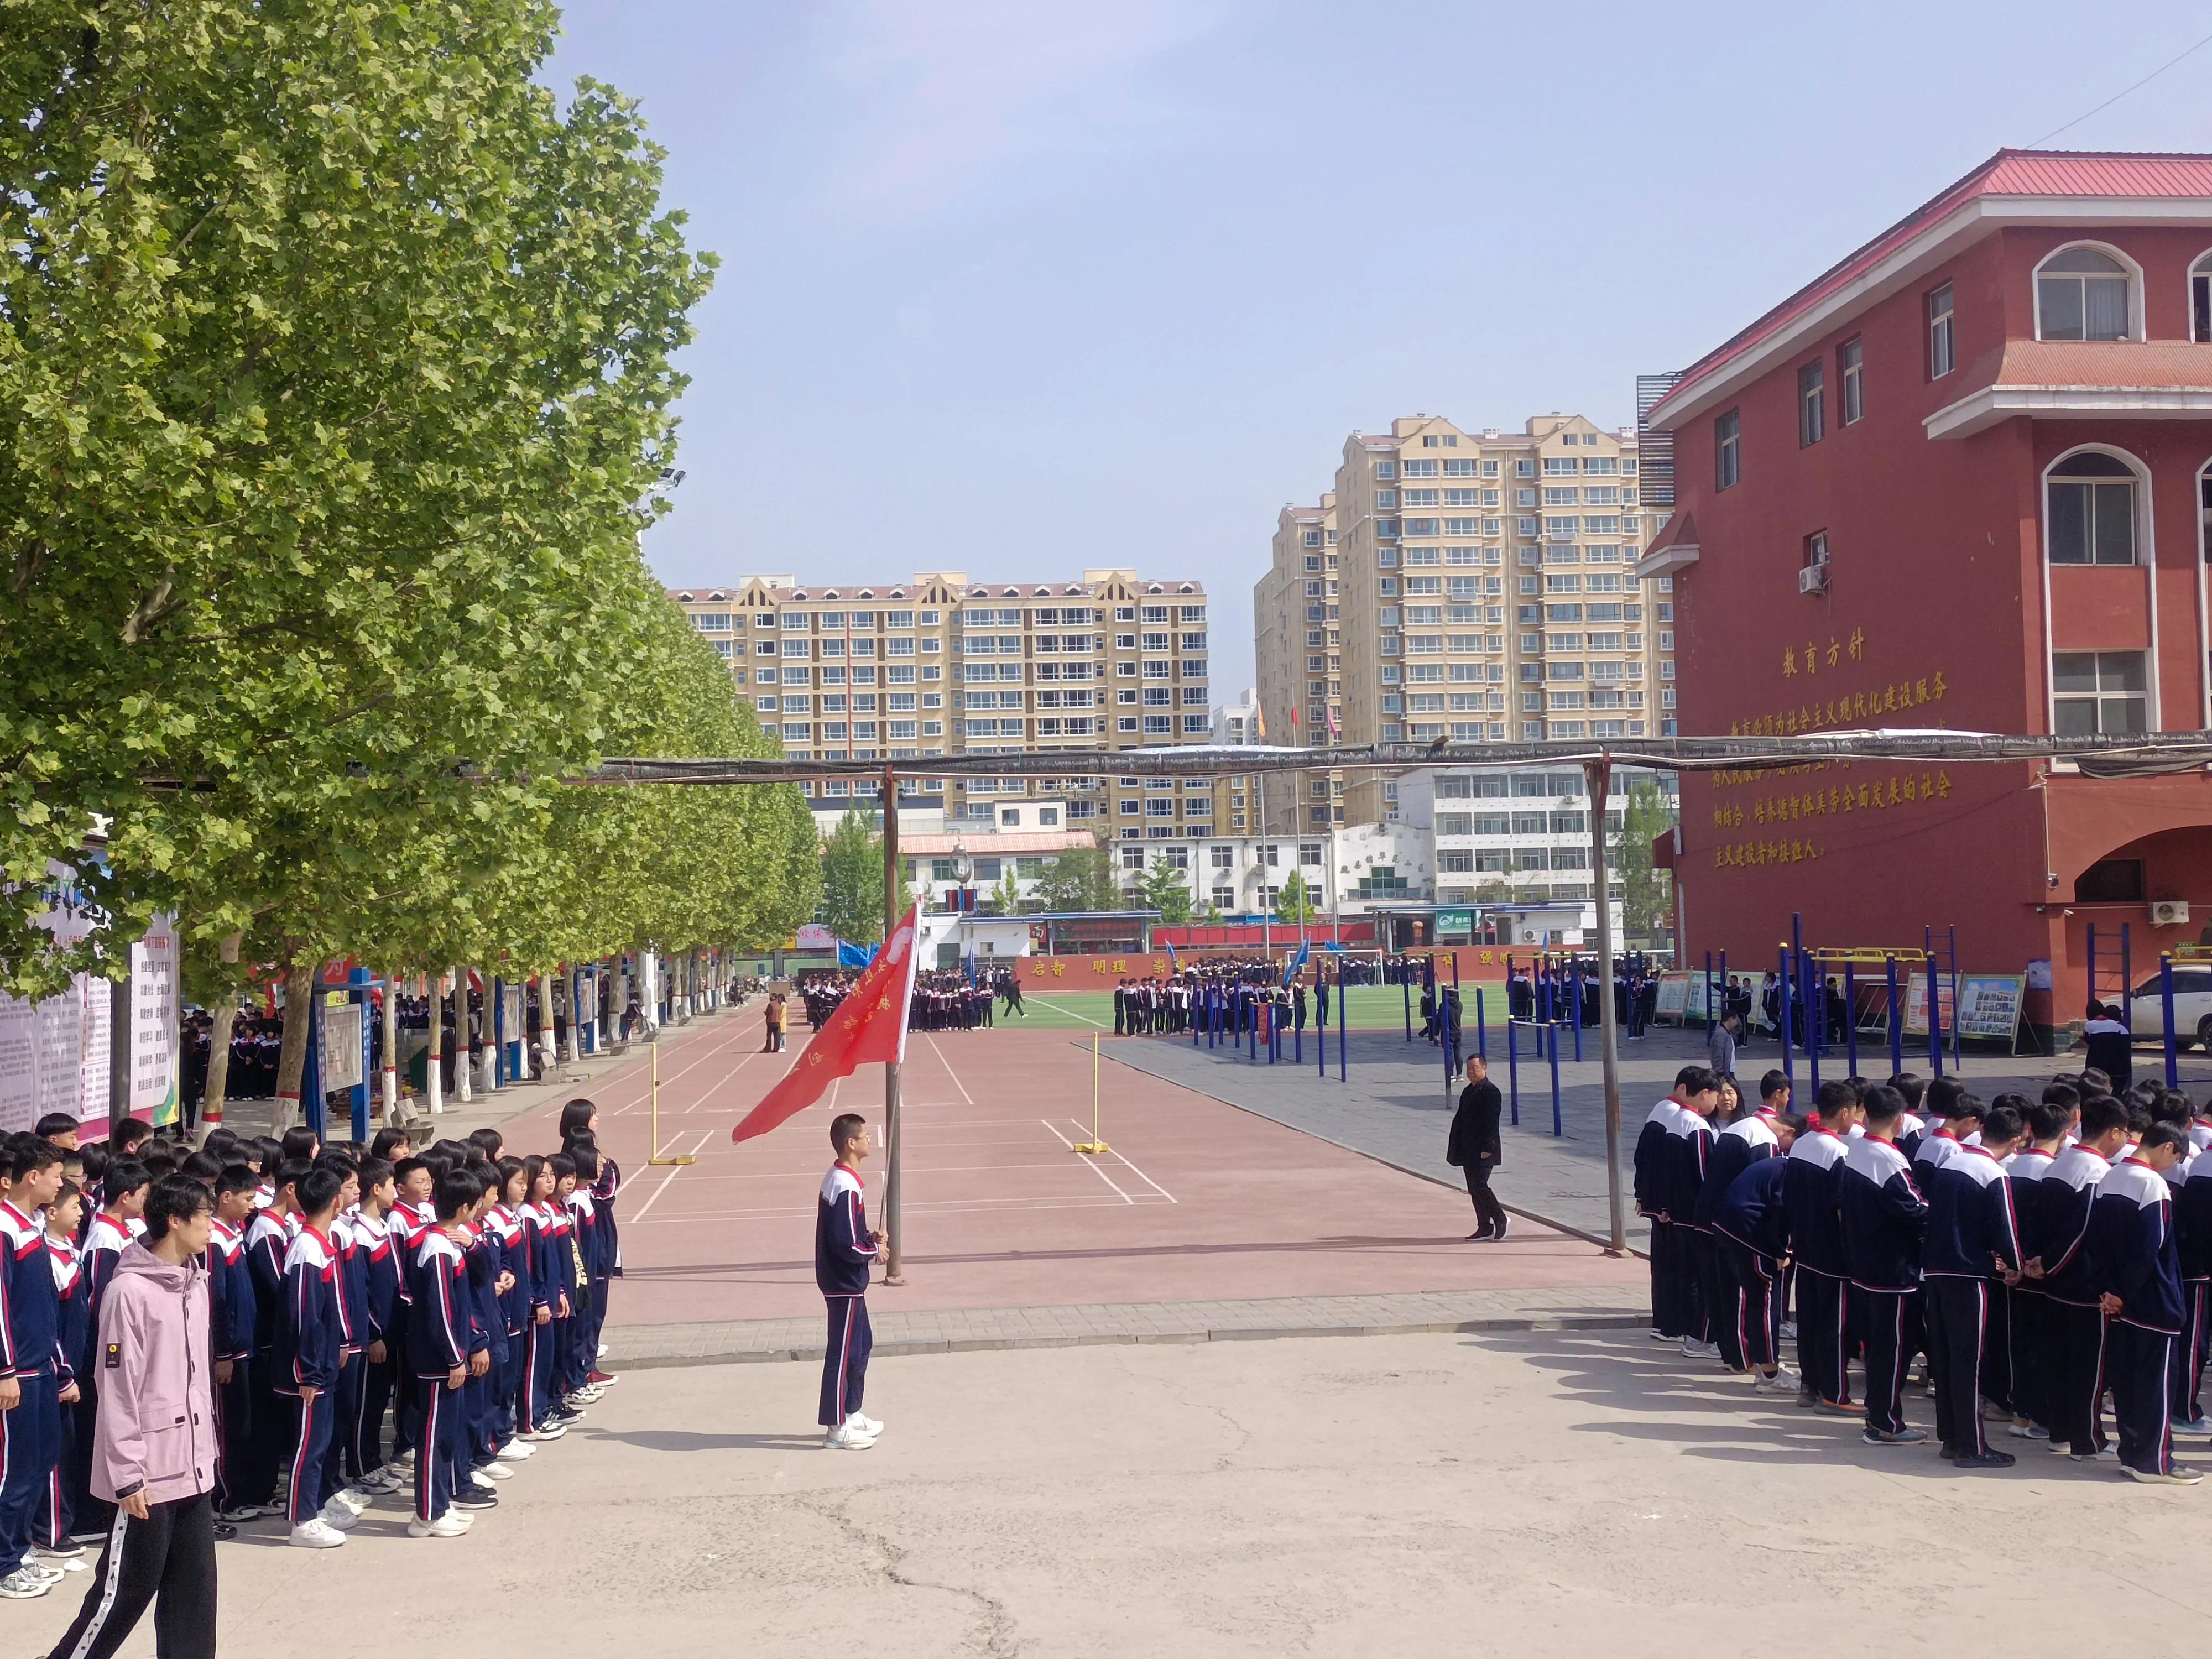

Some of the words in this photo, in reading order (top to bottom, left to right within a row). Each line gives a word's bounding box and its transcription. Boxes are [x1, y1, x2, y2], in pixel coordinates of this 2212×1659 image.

[1783, 627, 1864, 678] 教育方针
[1032, 959, 1066, 977] 启智
[1092, 960, 1127, 974] 明理
